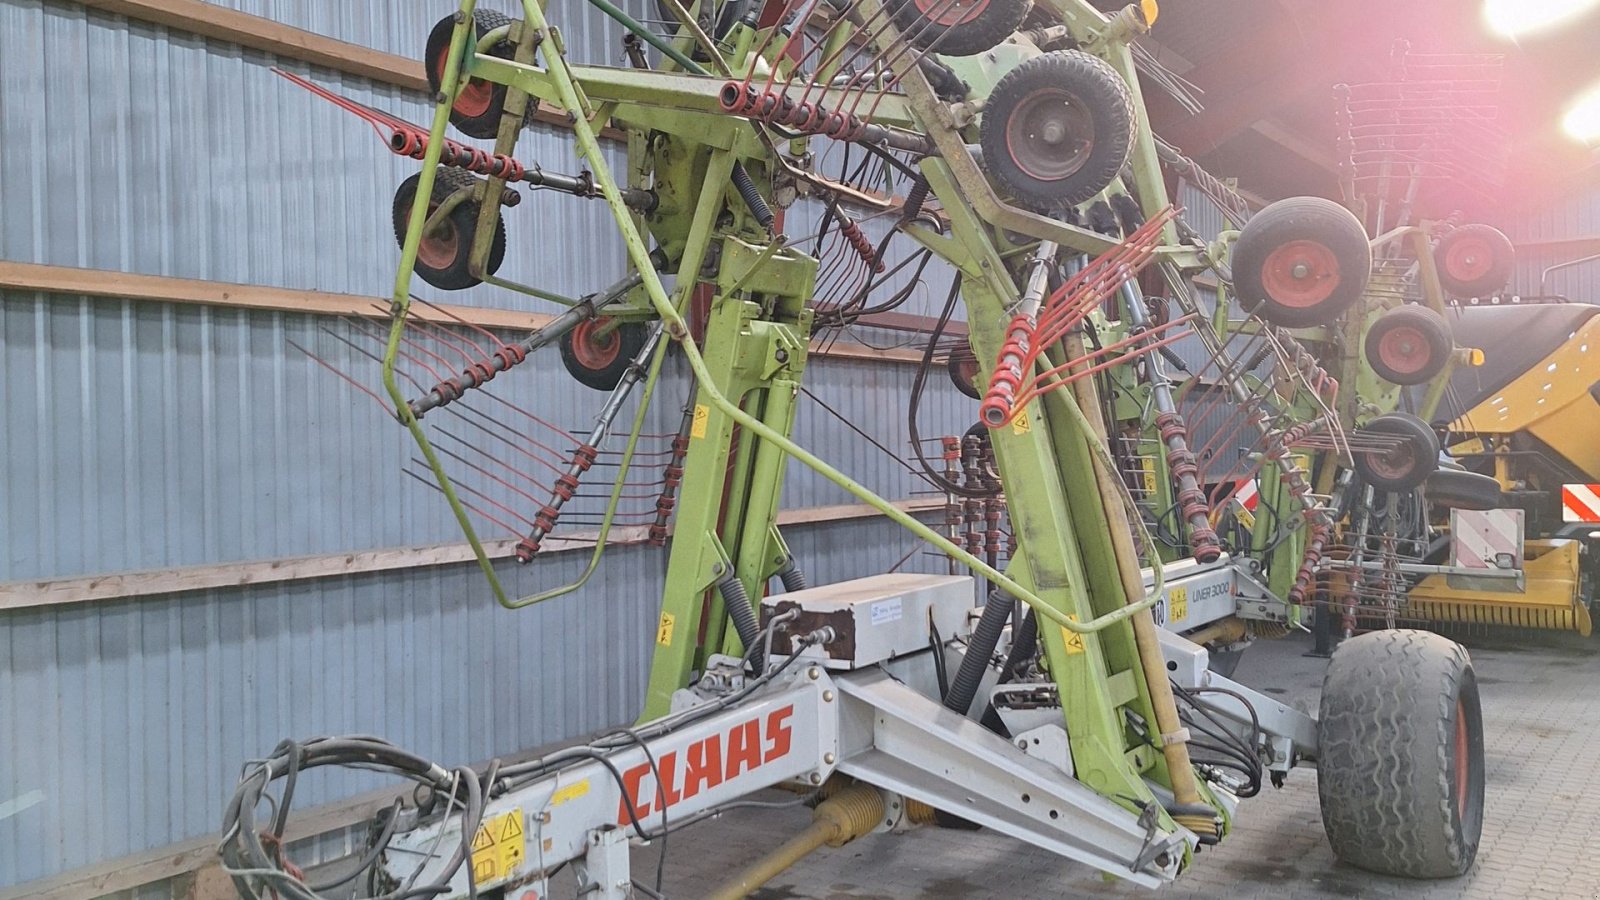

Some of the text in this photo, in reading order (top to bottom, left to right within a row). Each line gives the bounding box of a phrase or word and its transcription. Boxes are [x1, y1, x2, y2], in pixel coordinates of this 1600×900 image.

[1192, 581, 1230, 603] LINER 3000
[618, 704, 794, 826] CLAAS
